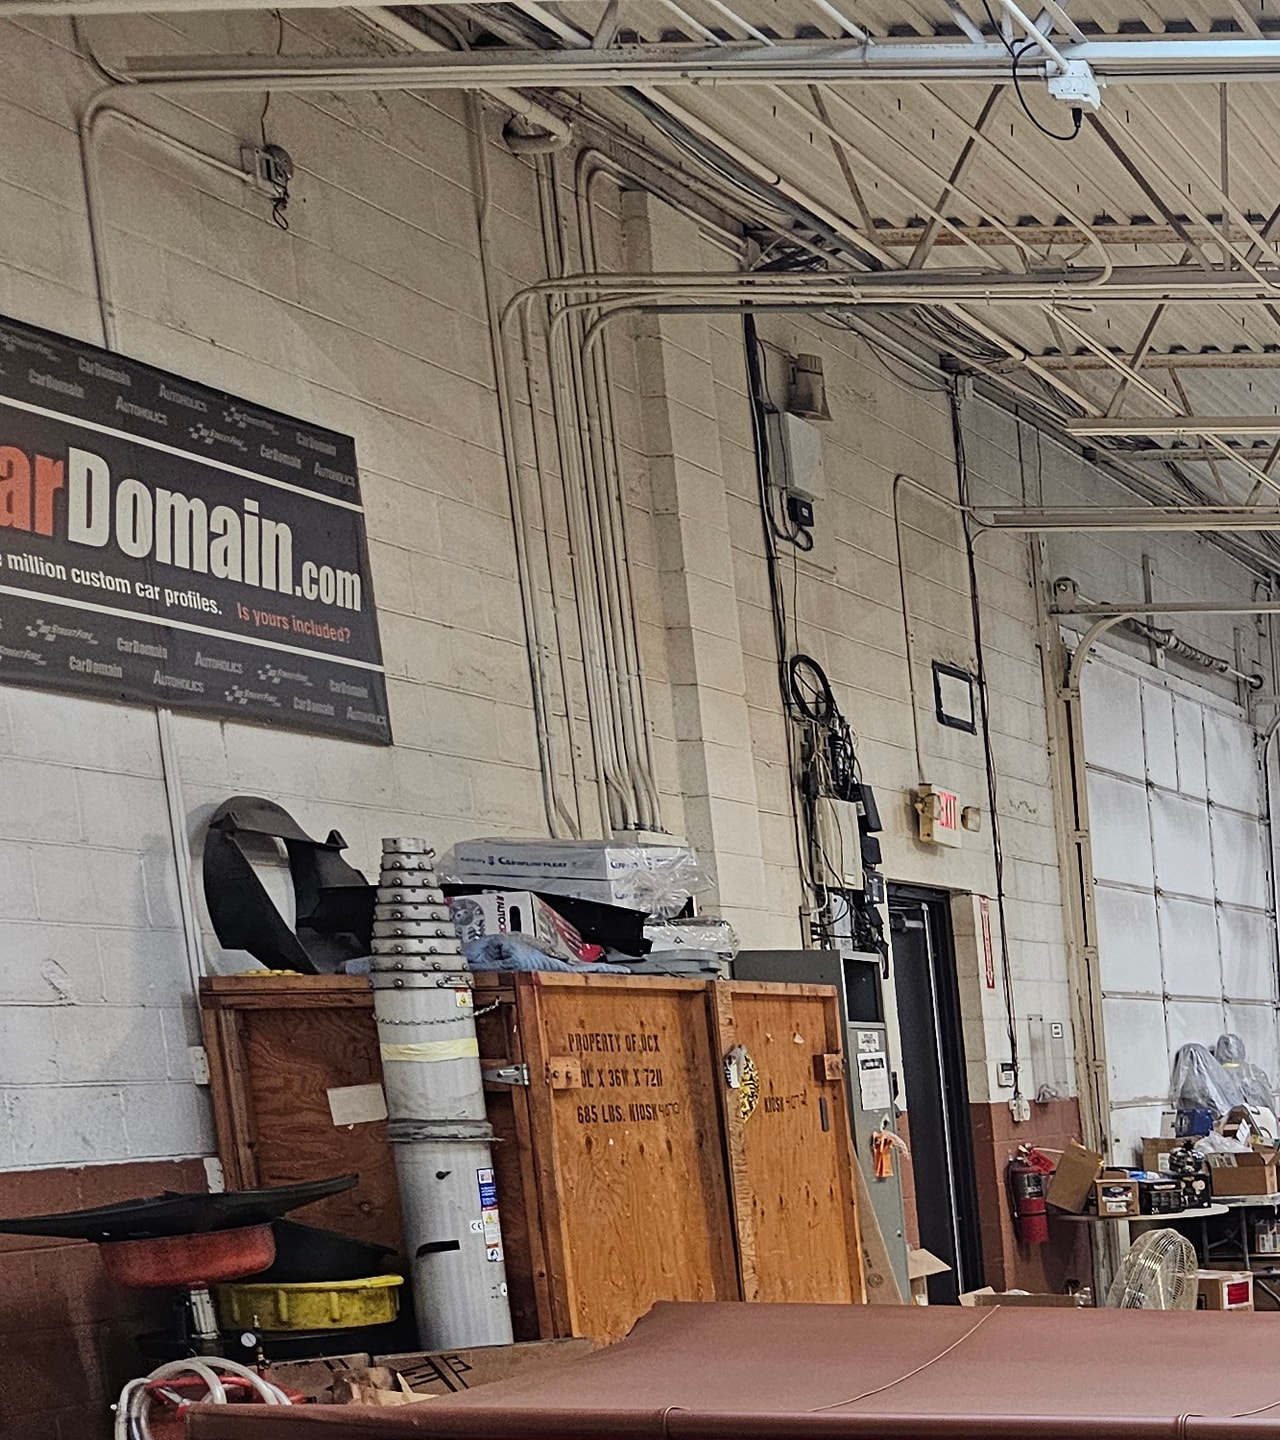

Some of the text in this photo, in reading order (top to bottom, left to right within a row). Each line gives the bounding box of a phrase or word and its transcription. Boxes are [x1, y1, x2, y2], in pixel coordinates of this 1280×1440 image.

[7, 552, 351, 644] million custom car profiles. Is yours included?
[117, 636, 168, 660] CarDomain
[69, 655, 123, 679] CarDomain
[568, 1032, 621, 1053] PROPERTY
[625, 1033, 637, 1053] OF
[597, 1068, 605, 1088] X
[608, 1068, 629, 1088] 36W
[633, 1068, 641, 1088] X
[577, 1104, 599, 1124] 685
[601, 1104, 626, 1124] LBS.
[628, 1103, 659, 1122] KIOSK
[763, 1095, 785, 1114] KIOSK
